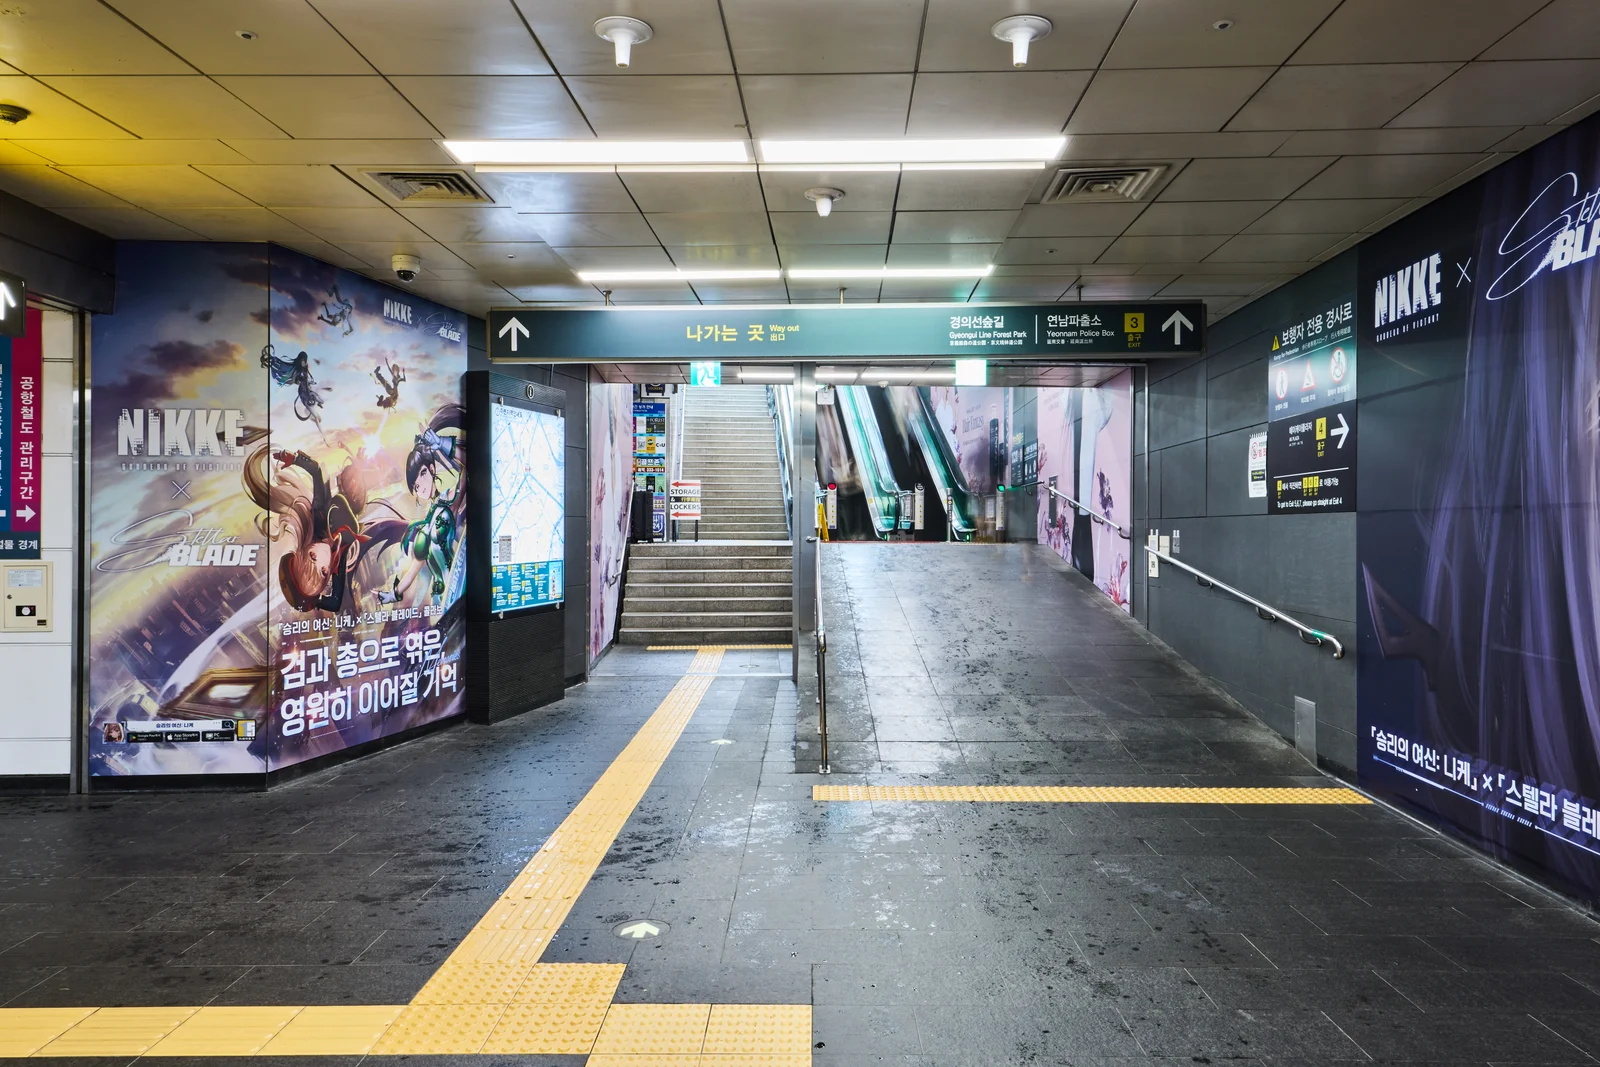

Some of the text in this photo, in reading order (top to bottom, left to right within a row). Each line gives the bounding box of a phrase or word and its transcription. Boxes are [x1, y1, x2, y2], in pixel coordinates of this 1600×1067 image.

[1375, 252, 1442, 328] NIKKE
[383, 298, 412, 325] NIKKE
[950, 315, 1004, 329] 경의선숲길
[1047, 313, 1102, 327] 연남파출소
[1130, 317, 1138, 328] 3
[1282, 301, 1352, 346] 보행자 전용 경사로
[439, 327, 461, 342] BLADE
[686, 324, 765, 342] 나가는 곳
[769, 324, 786, 333] Way
[949, 331, 977, 339] Gyeongui
[770, 333, 785, 342] 出口
[1127, 334, 1141, 342] 출구
[20, 376, 34, 500] 공항철도 관리구간
[117, 408, 245, 456] NIKKE
[176, 463, 187, 472] OF
[195, 463, 242, 471] VICTORY
[18, 539, 38, 550] 경계
[168, 544, 260, 567] BLADE
[280, 646, 331, 690] 검과
[336, 636, 400, 679] 총으로
[280, 662, 457, 737] 영원히 이어질 기억
[1412, 742, 1440, 773] 여신:
[1562, 798, 1600, 841] 블레
